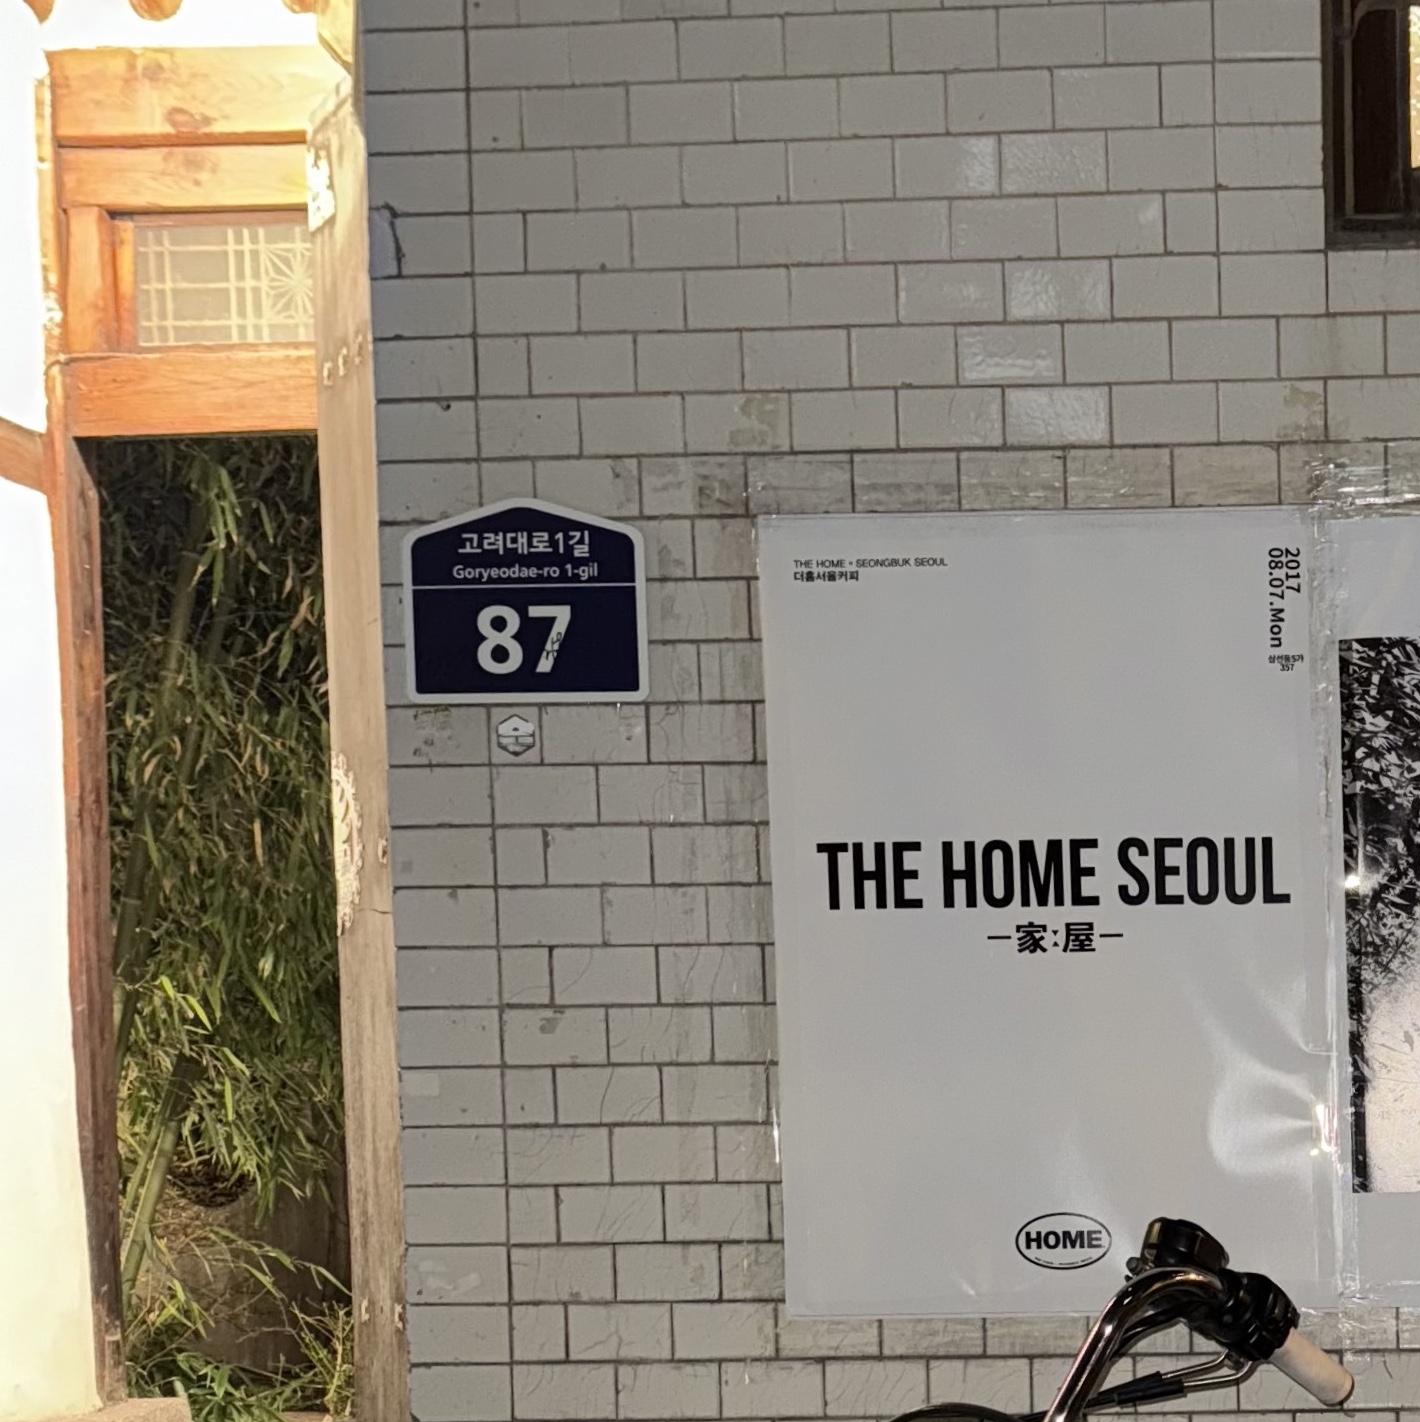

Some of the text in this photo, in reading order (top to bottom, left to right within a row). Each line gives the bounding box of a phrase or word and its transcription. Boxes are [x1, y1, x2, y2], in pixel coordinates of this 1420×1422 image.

[457, 530, 590, 557] 고려대로1길
[452, 562, 598, 582] Goryeodae-ro 1-gil
[793, 557, 948, 569] THE HOME SEONGBUK SEOUL
[1284, 547, 1301, 593] 2017
[1268, 547, 1285, 648] 08.07.Mon
[476, 604, 572, 675] 87
[816, 836, 1292, 910] THE HOME SEOUL
[1025, 1229, 1103, 1250] HOME
